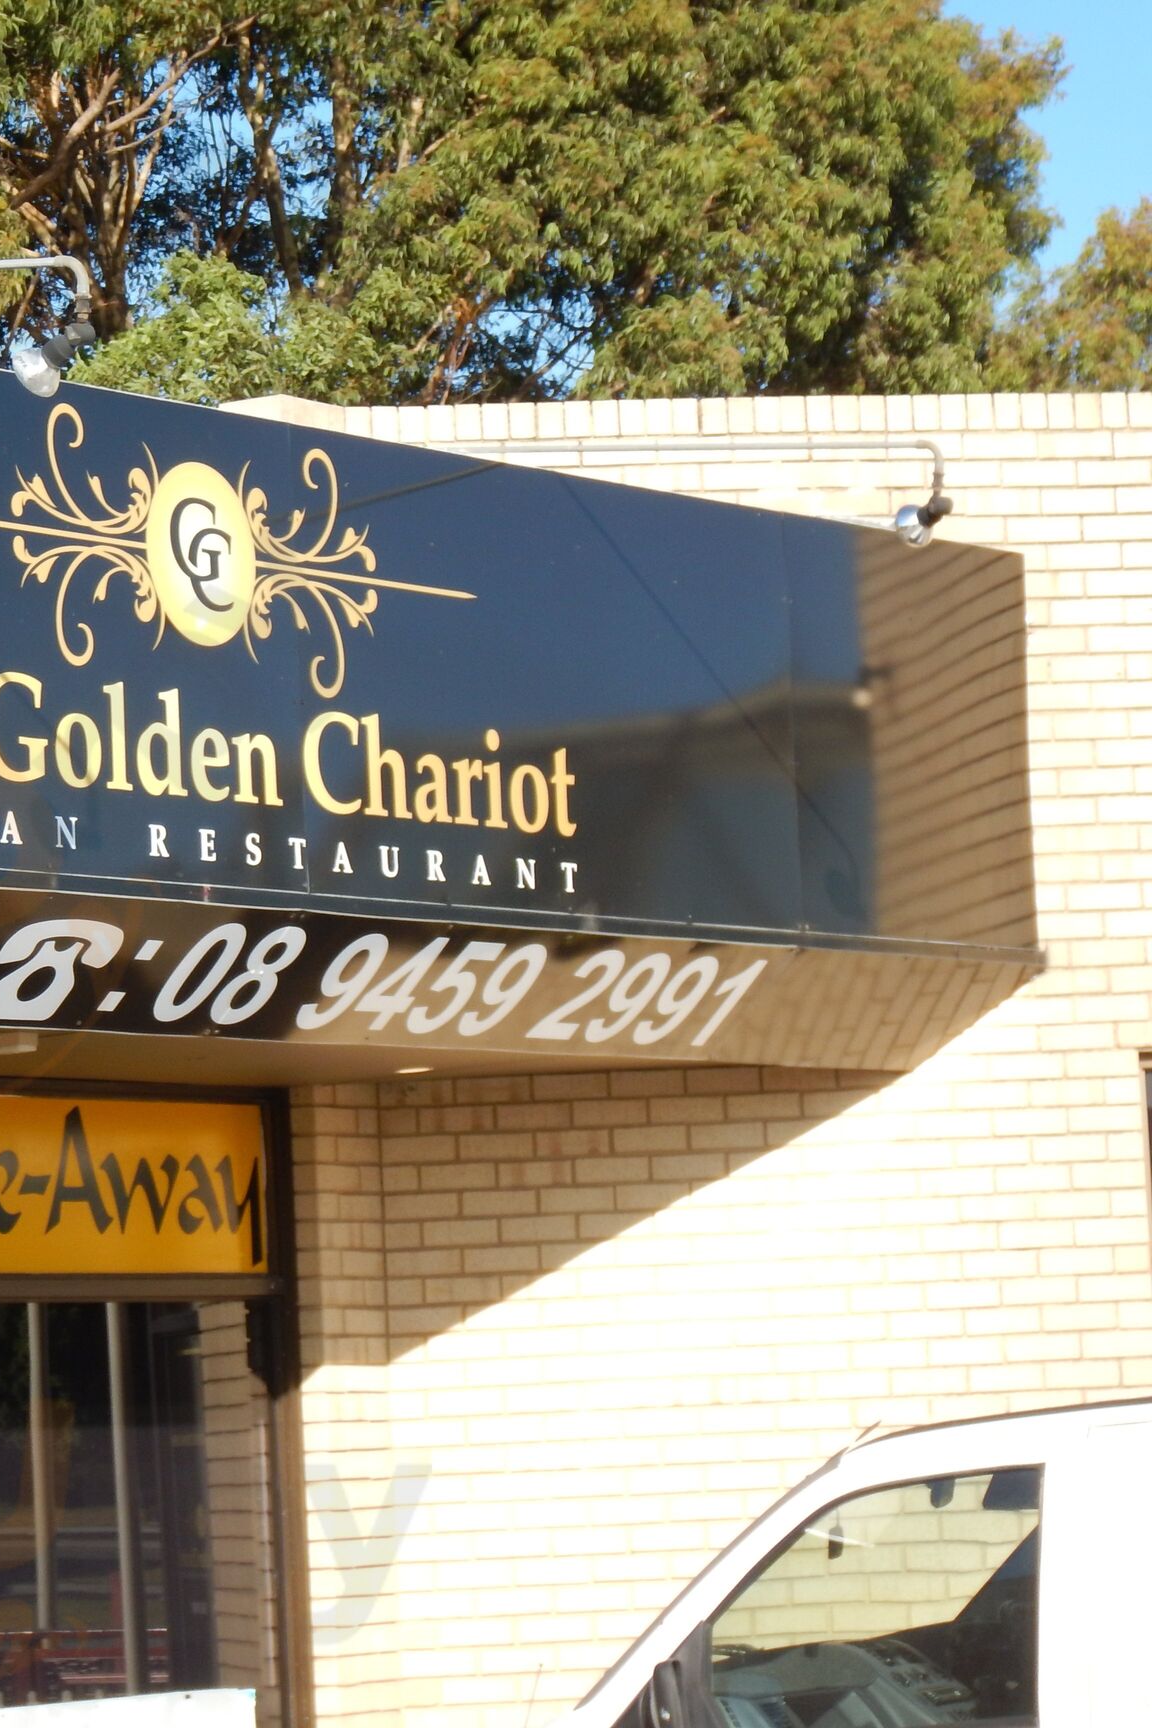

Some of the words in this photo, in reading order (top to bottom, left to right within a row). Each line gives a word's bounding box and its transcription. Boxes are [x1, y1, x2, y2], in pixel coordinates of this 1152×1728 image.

[301, 709, 578, 838] Chariot
[148, 824, 578, 893] RESTAURANT
[295, 932, 548, 1037] 9459
[525, 948, 769, 1047] 2991
